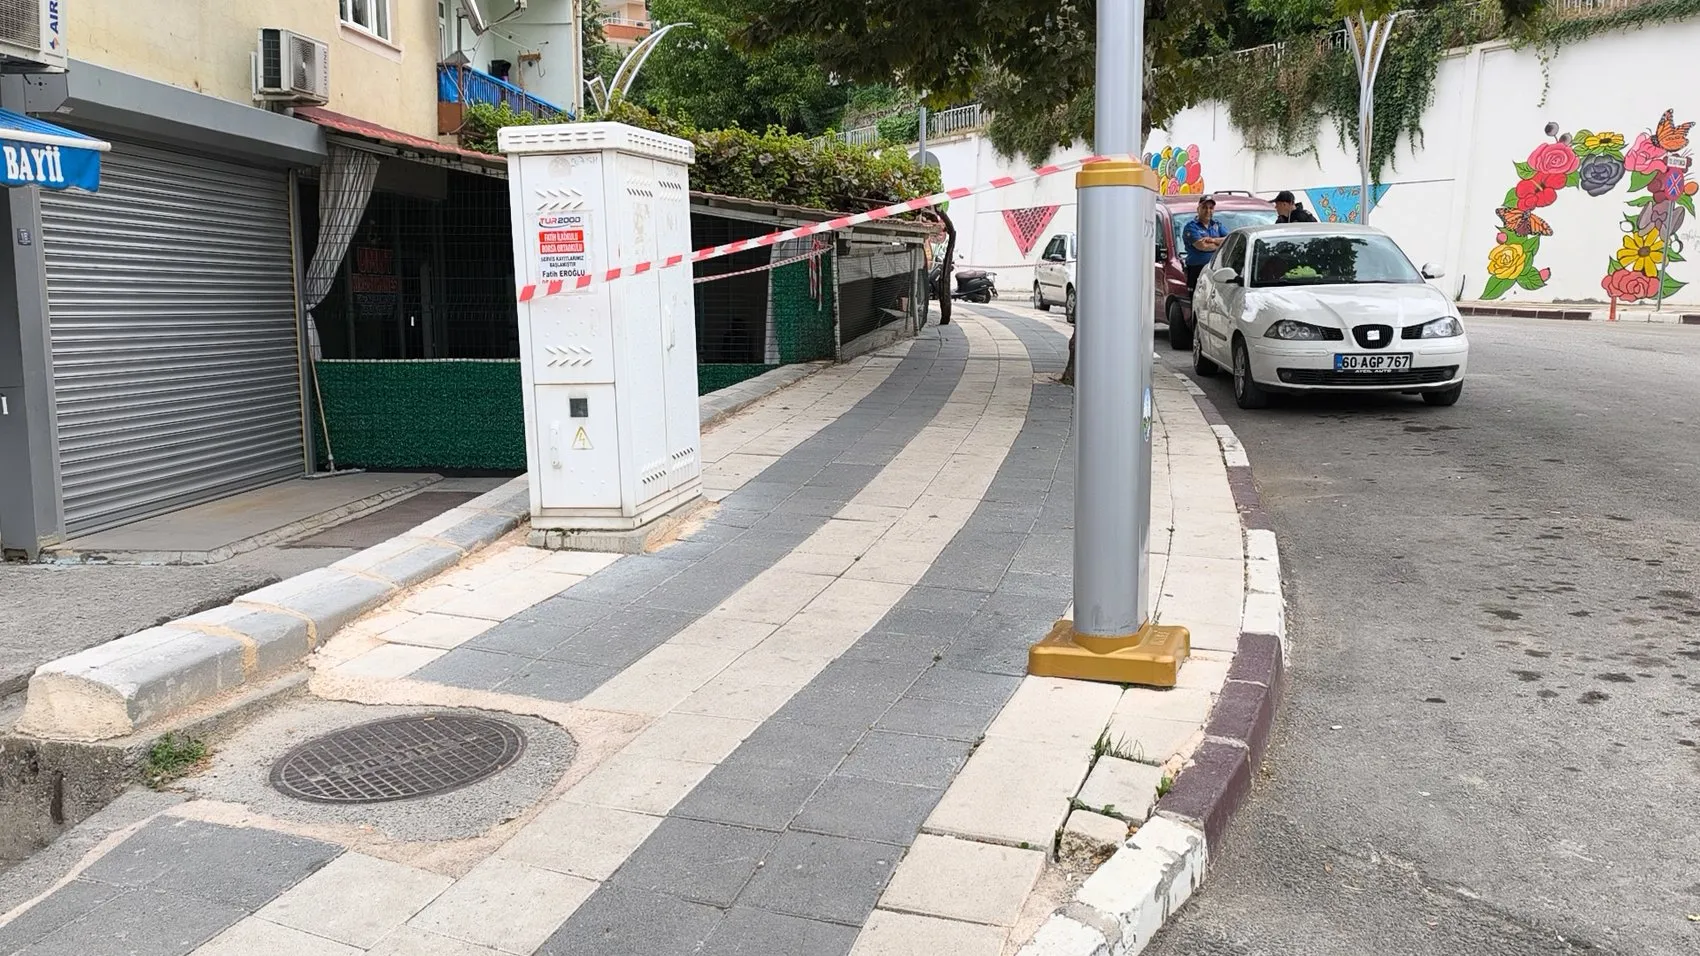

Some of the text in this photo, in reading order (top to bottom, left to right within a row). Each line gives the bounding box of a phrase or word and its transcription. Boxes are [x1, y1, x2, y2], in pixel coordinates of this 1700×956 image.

[542, 268, 586, 278] Fatih EROĞLU
[1342, 356, 1409, 368] 60 AGP 767
